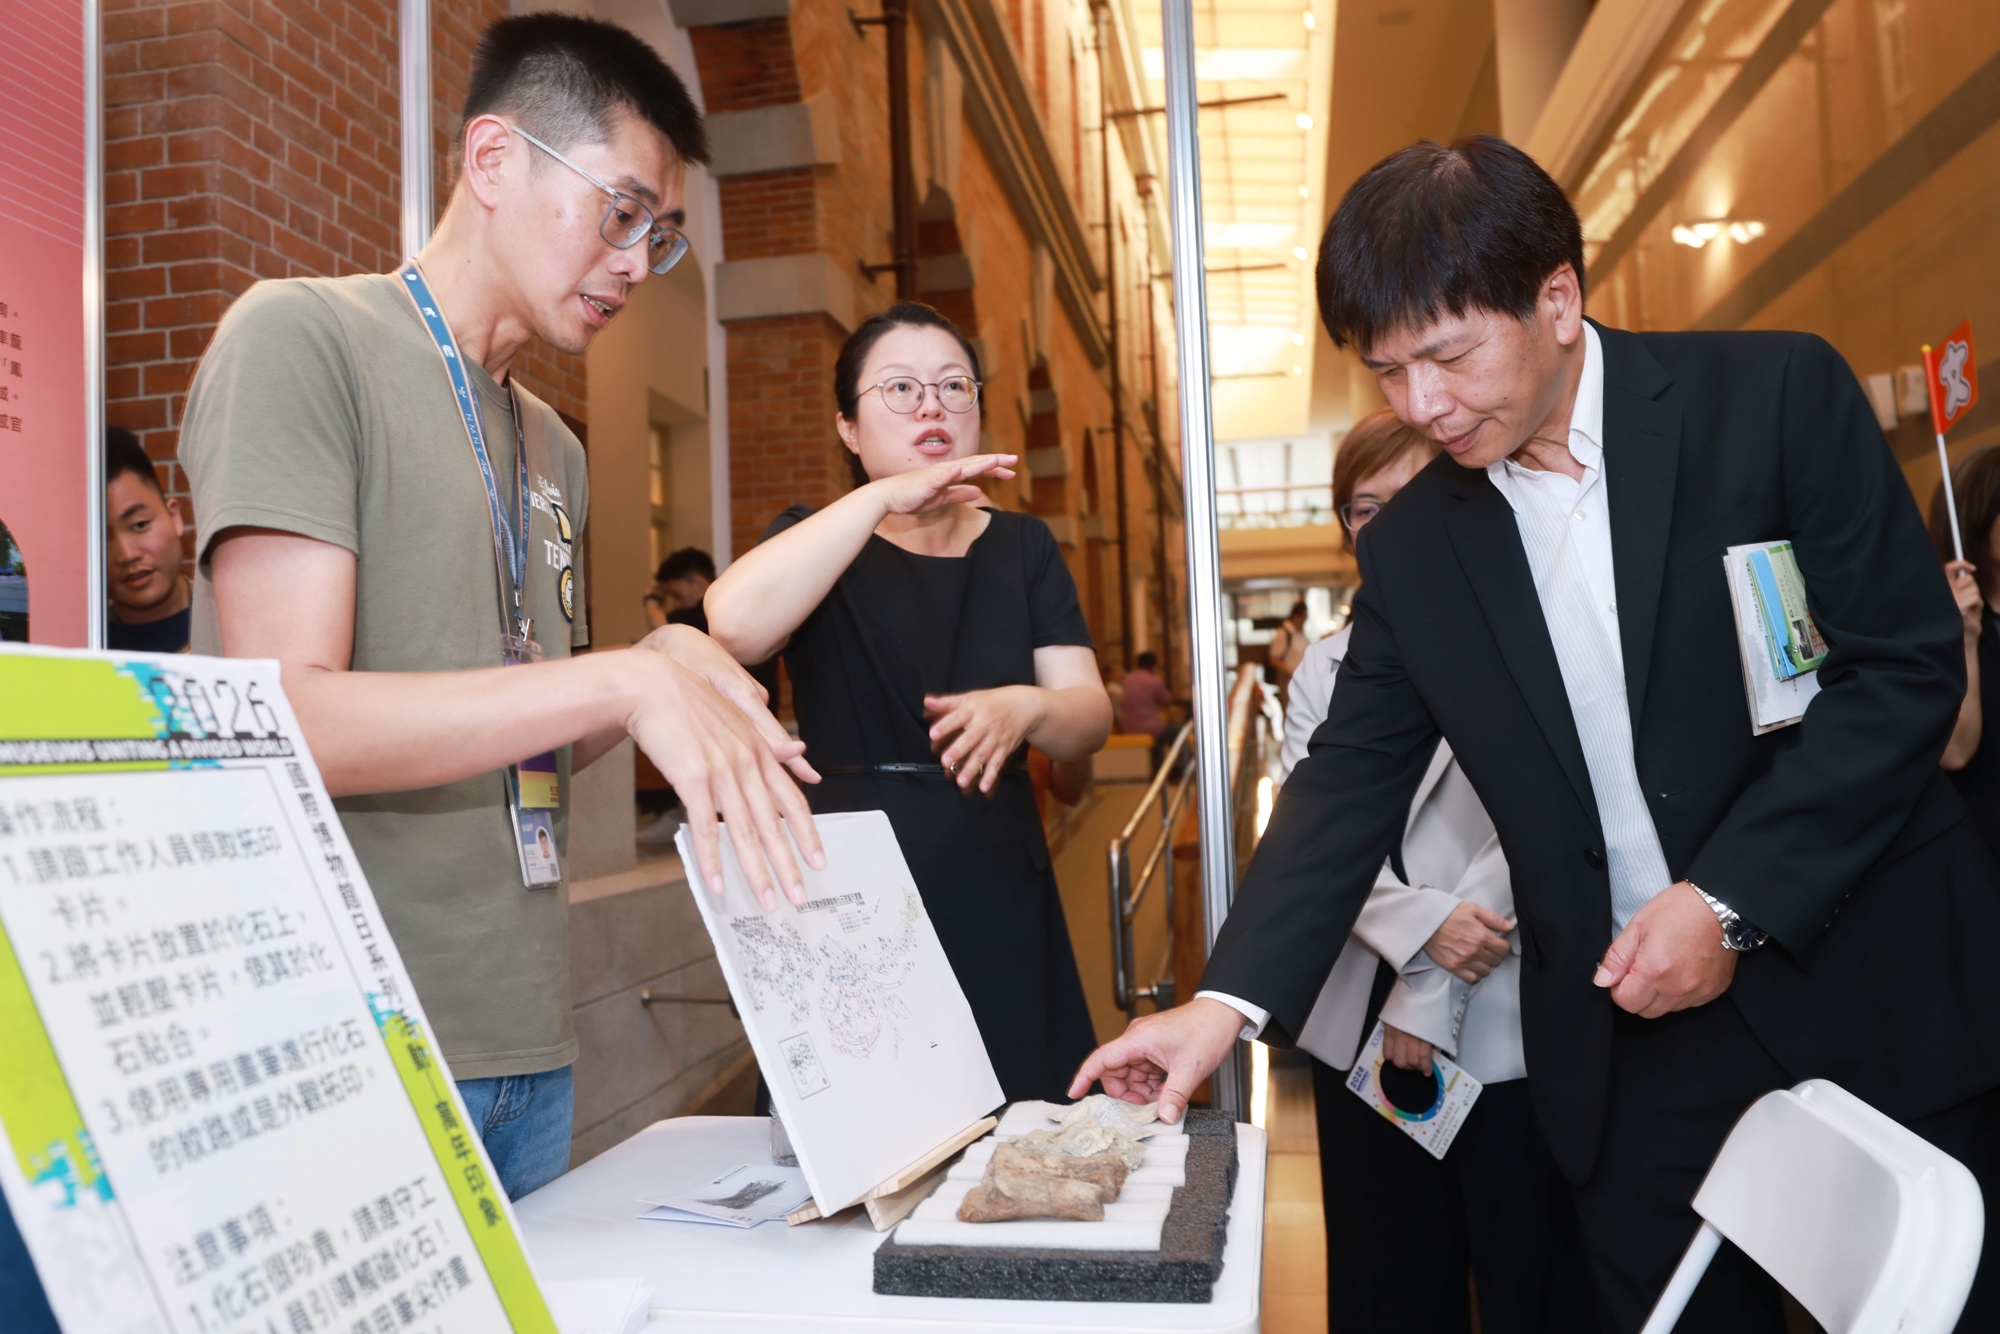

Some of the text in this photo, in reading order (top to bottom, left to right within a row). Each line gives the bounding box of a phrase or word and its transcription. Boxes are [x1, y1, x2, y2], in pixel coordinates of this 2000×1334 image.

[465, 413, 483, 452] NMNS
[150, 677, 281, 739] 2026
[94, 738, 168, 761] UNITING
[168, 738, 184, 759] A
[181, 738, 243, 759] DIVIDED
[241, 737, 294, 757] WORLD
